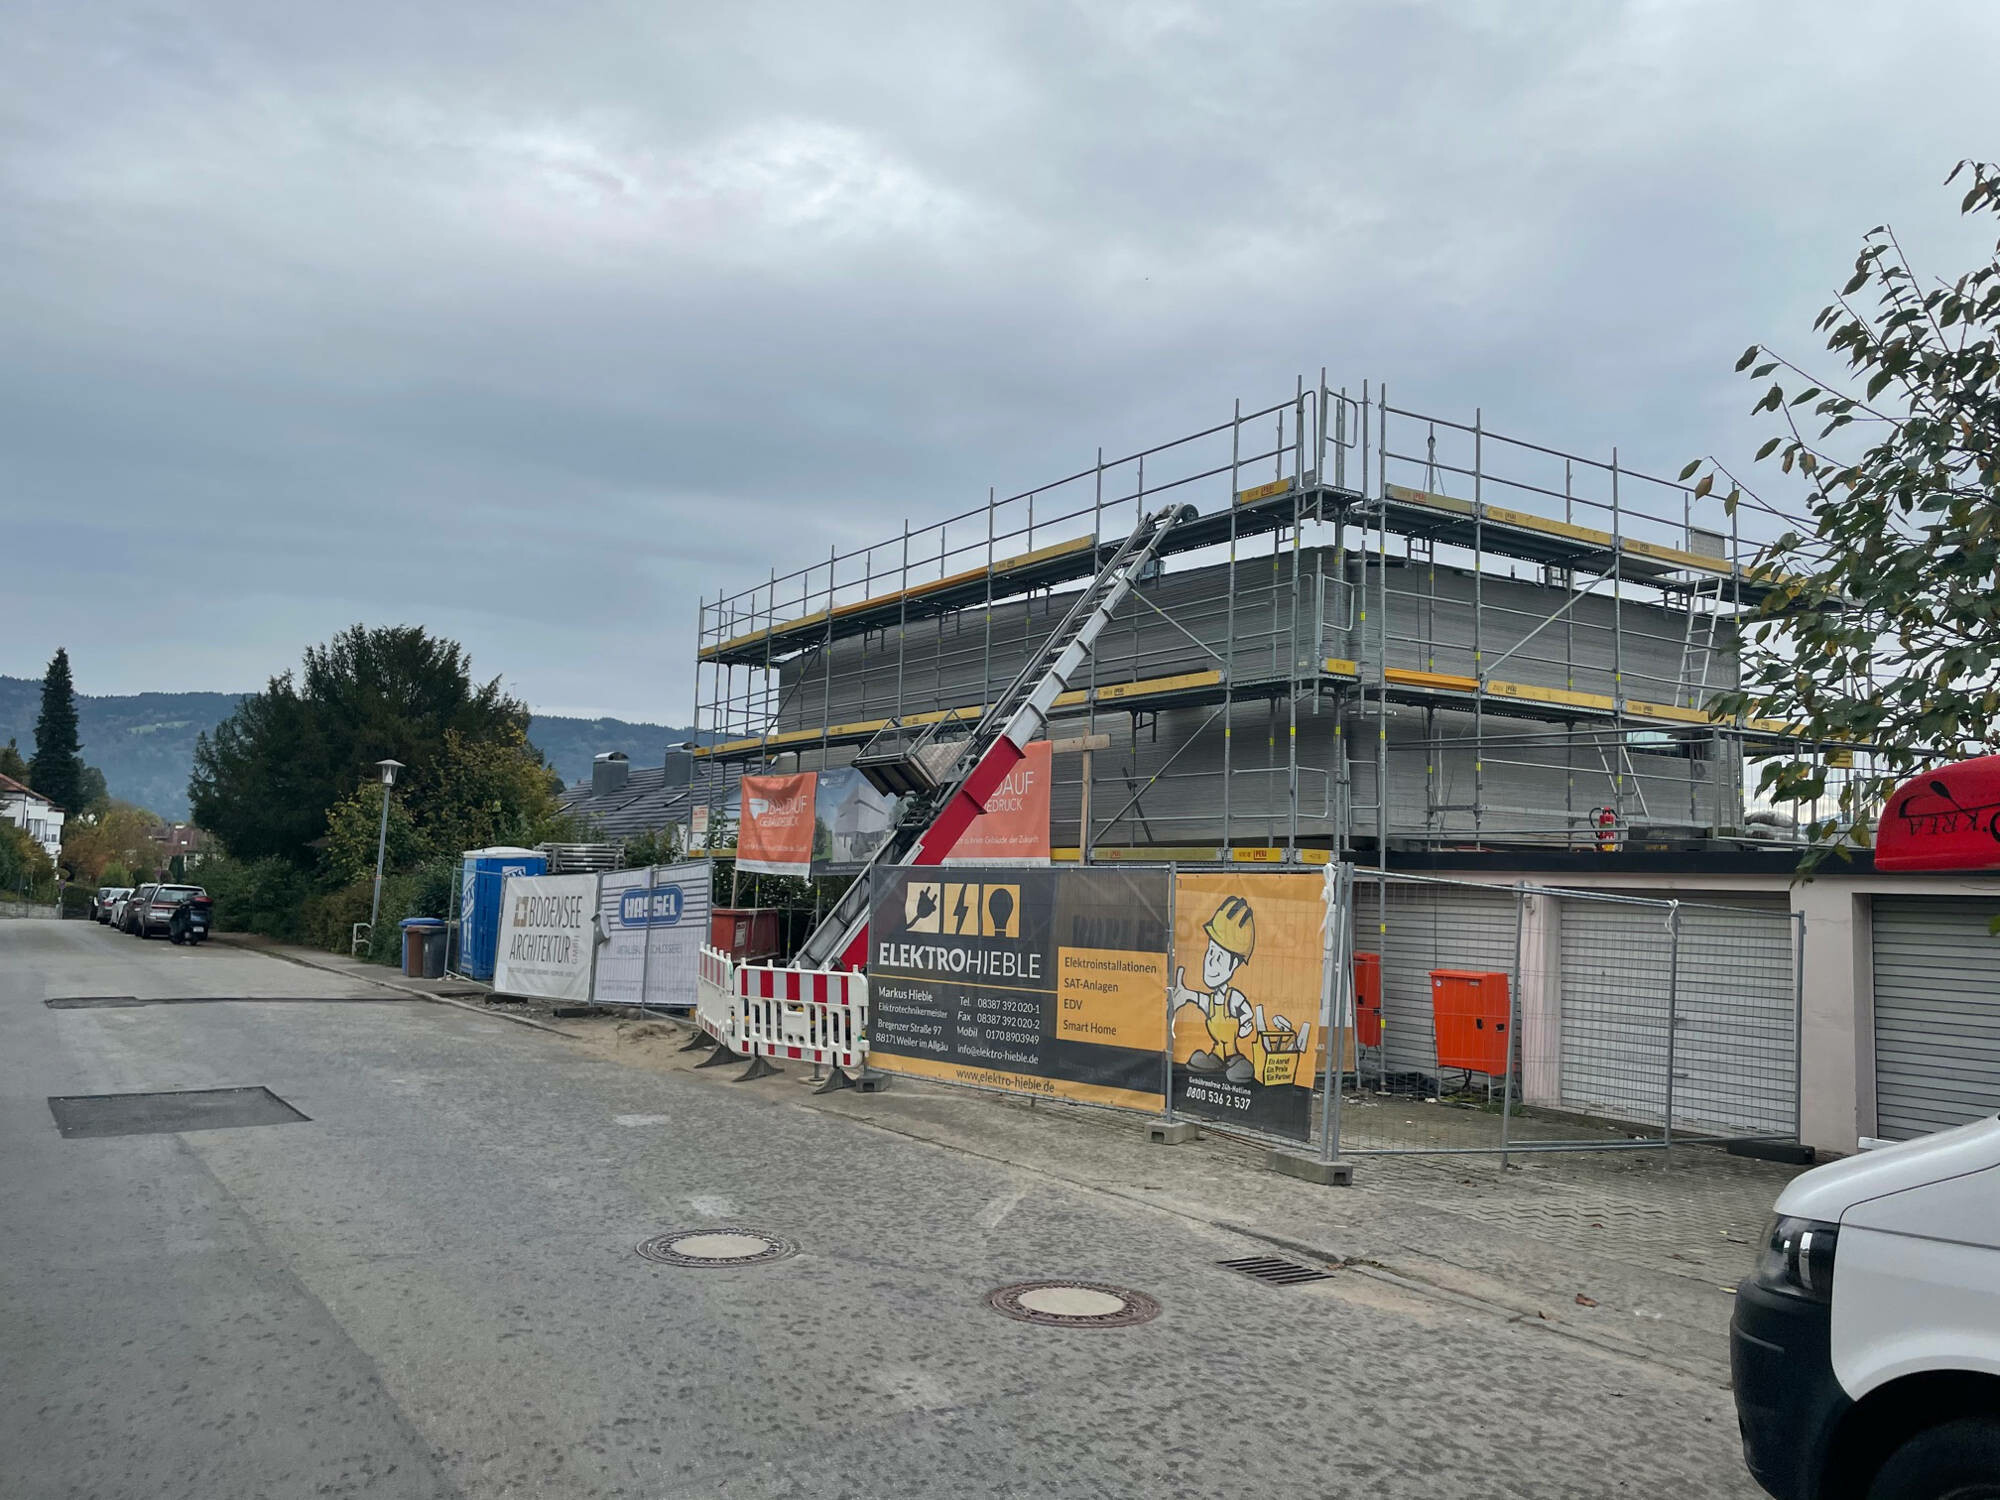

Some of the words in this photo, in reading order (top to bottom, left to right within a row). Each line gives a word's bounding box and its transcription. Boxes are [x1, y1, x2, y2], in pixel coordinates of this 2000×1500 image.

[991, 771, 1035, 796] DAUF
[1255, 849, 1267, 858] PERI
[529, 896, 583, 928] BODENSEE
[509, 934, 571, 964] ARCHITEKTUR
[879, 942, 1041, 979] ELEKTROHIEBLE
[1064, 956, 1157, 974] Elektroinstallationen
[878, 986, 908, 1000] Markus
[908, 989, 934, 1002] Hieble
[1064, 977, 1119, 994] SAT-Anlagen
[878, 1002, 948, 1019] Elektrotechnikermeister
[977, 998, 1001, 1009] 08387
[1002, 1000, 1017, 1012] 392
[1017, 1002, 1040, 1014] 020-1
[1063, 998, 1083, 1010] EDV
[877, 1018, 910, 1031] Bregenzer
[910, 1023, 932, 1035] Straße
[932, 1026, 942, 1036] 97
[957, 1011, 971, 1022] Fax
[976, 1013, 1001, 1025] 08387
[1002, 1015, 1017, 1027] 392
[1017, 1017, 1040, 1030] 020-2
[1063, 1020, 1088, 1033] Smart
[1090, 1023, 1117, 1036] Home
[875, 1033, 896, 1045] 88171
[896, 1036, 918, 1048] Weiler
[919, 1038, 928, 1048] im
[928, 1040, 949, 1053] Allgäu
[957, 1025, 978, 1038] Mobil
[985, 1029, 1005, 1041] 0170
[1005, 1031, 1040, 1045] 8903949
[957, 1044, 1039, 1065] info@elektro-hieble.de
[955, 1069, 1055, 1093] www.elektro-hieble.de
[1186, 1086, 1206, 1101] 0800
[1208, 1091, 1224, 1104] 536
[1225, 1095, 1232, 1106] 2
[1234, 1096, 1251, 1111] 537
